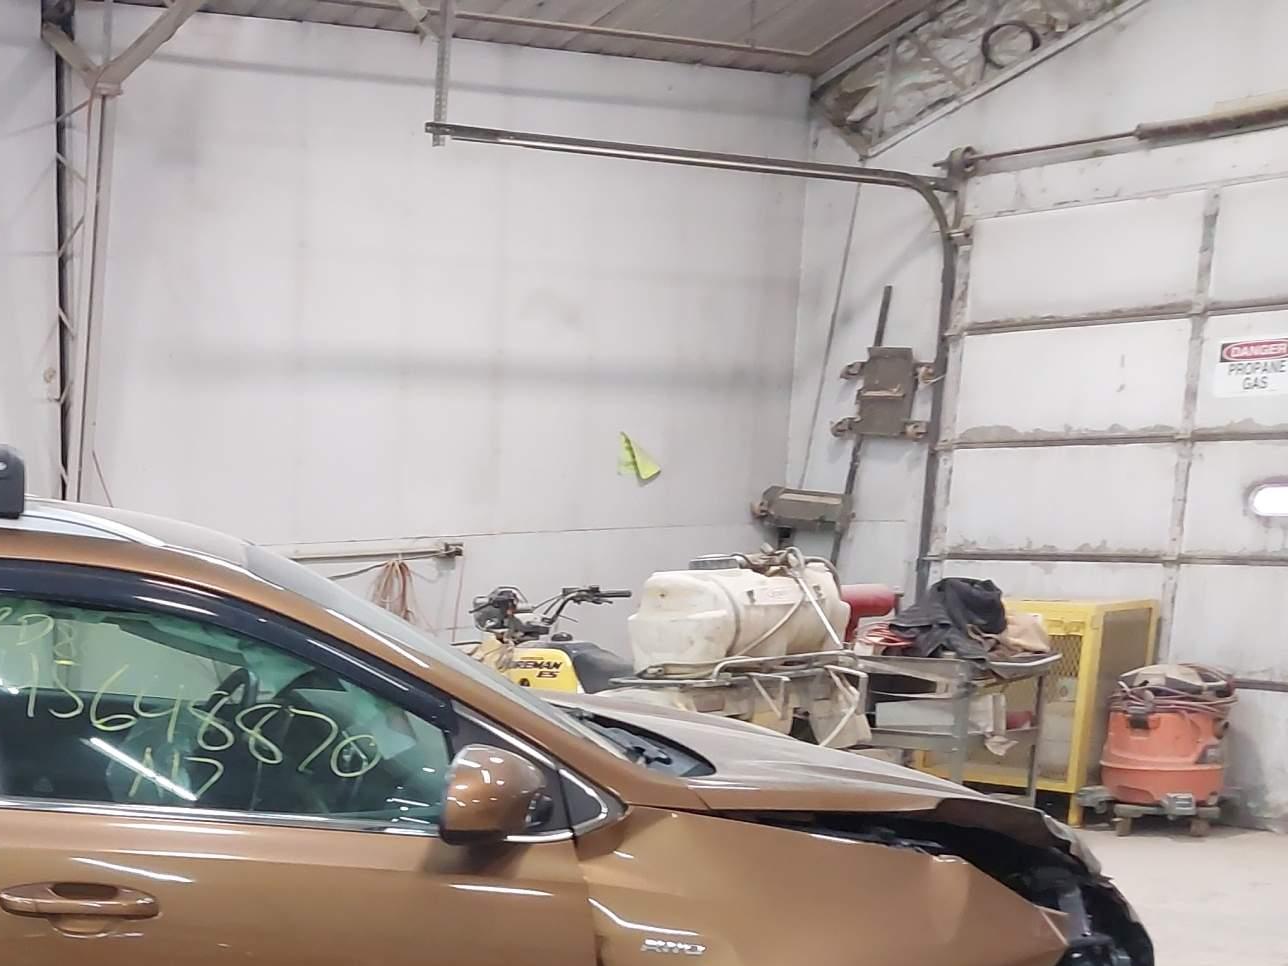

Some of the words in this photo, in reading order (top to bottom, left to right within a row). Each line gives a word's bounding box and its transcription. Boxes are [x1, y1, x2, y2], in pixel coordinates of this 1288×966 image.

[1230, 342, 1288, 358] DANGER
[1228, 359, 1287, 375] PROPANE
[1242, 375, 1268, 390] GAS
